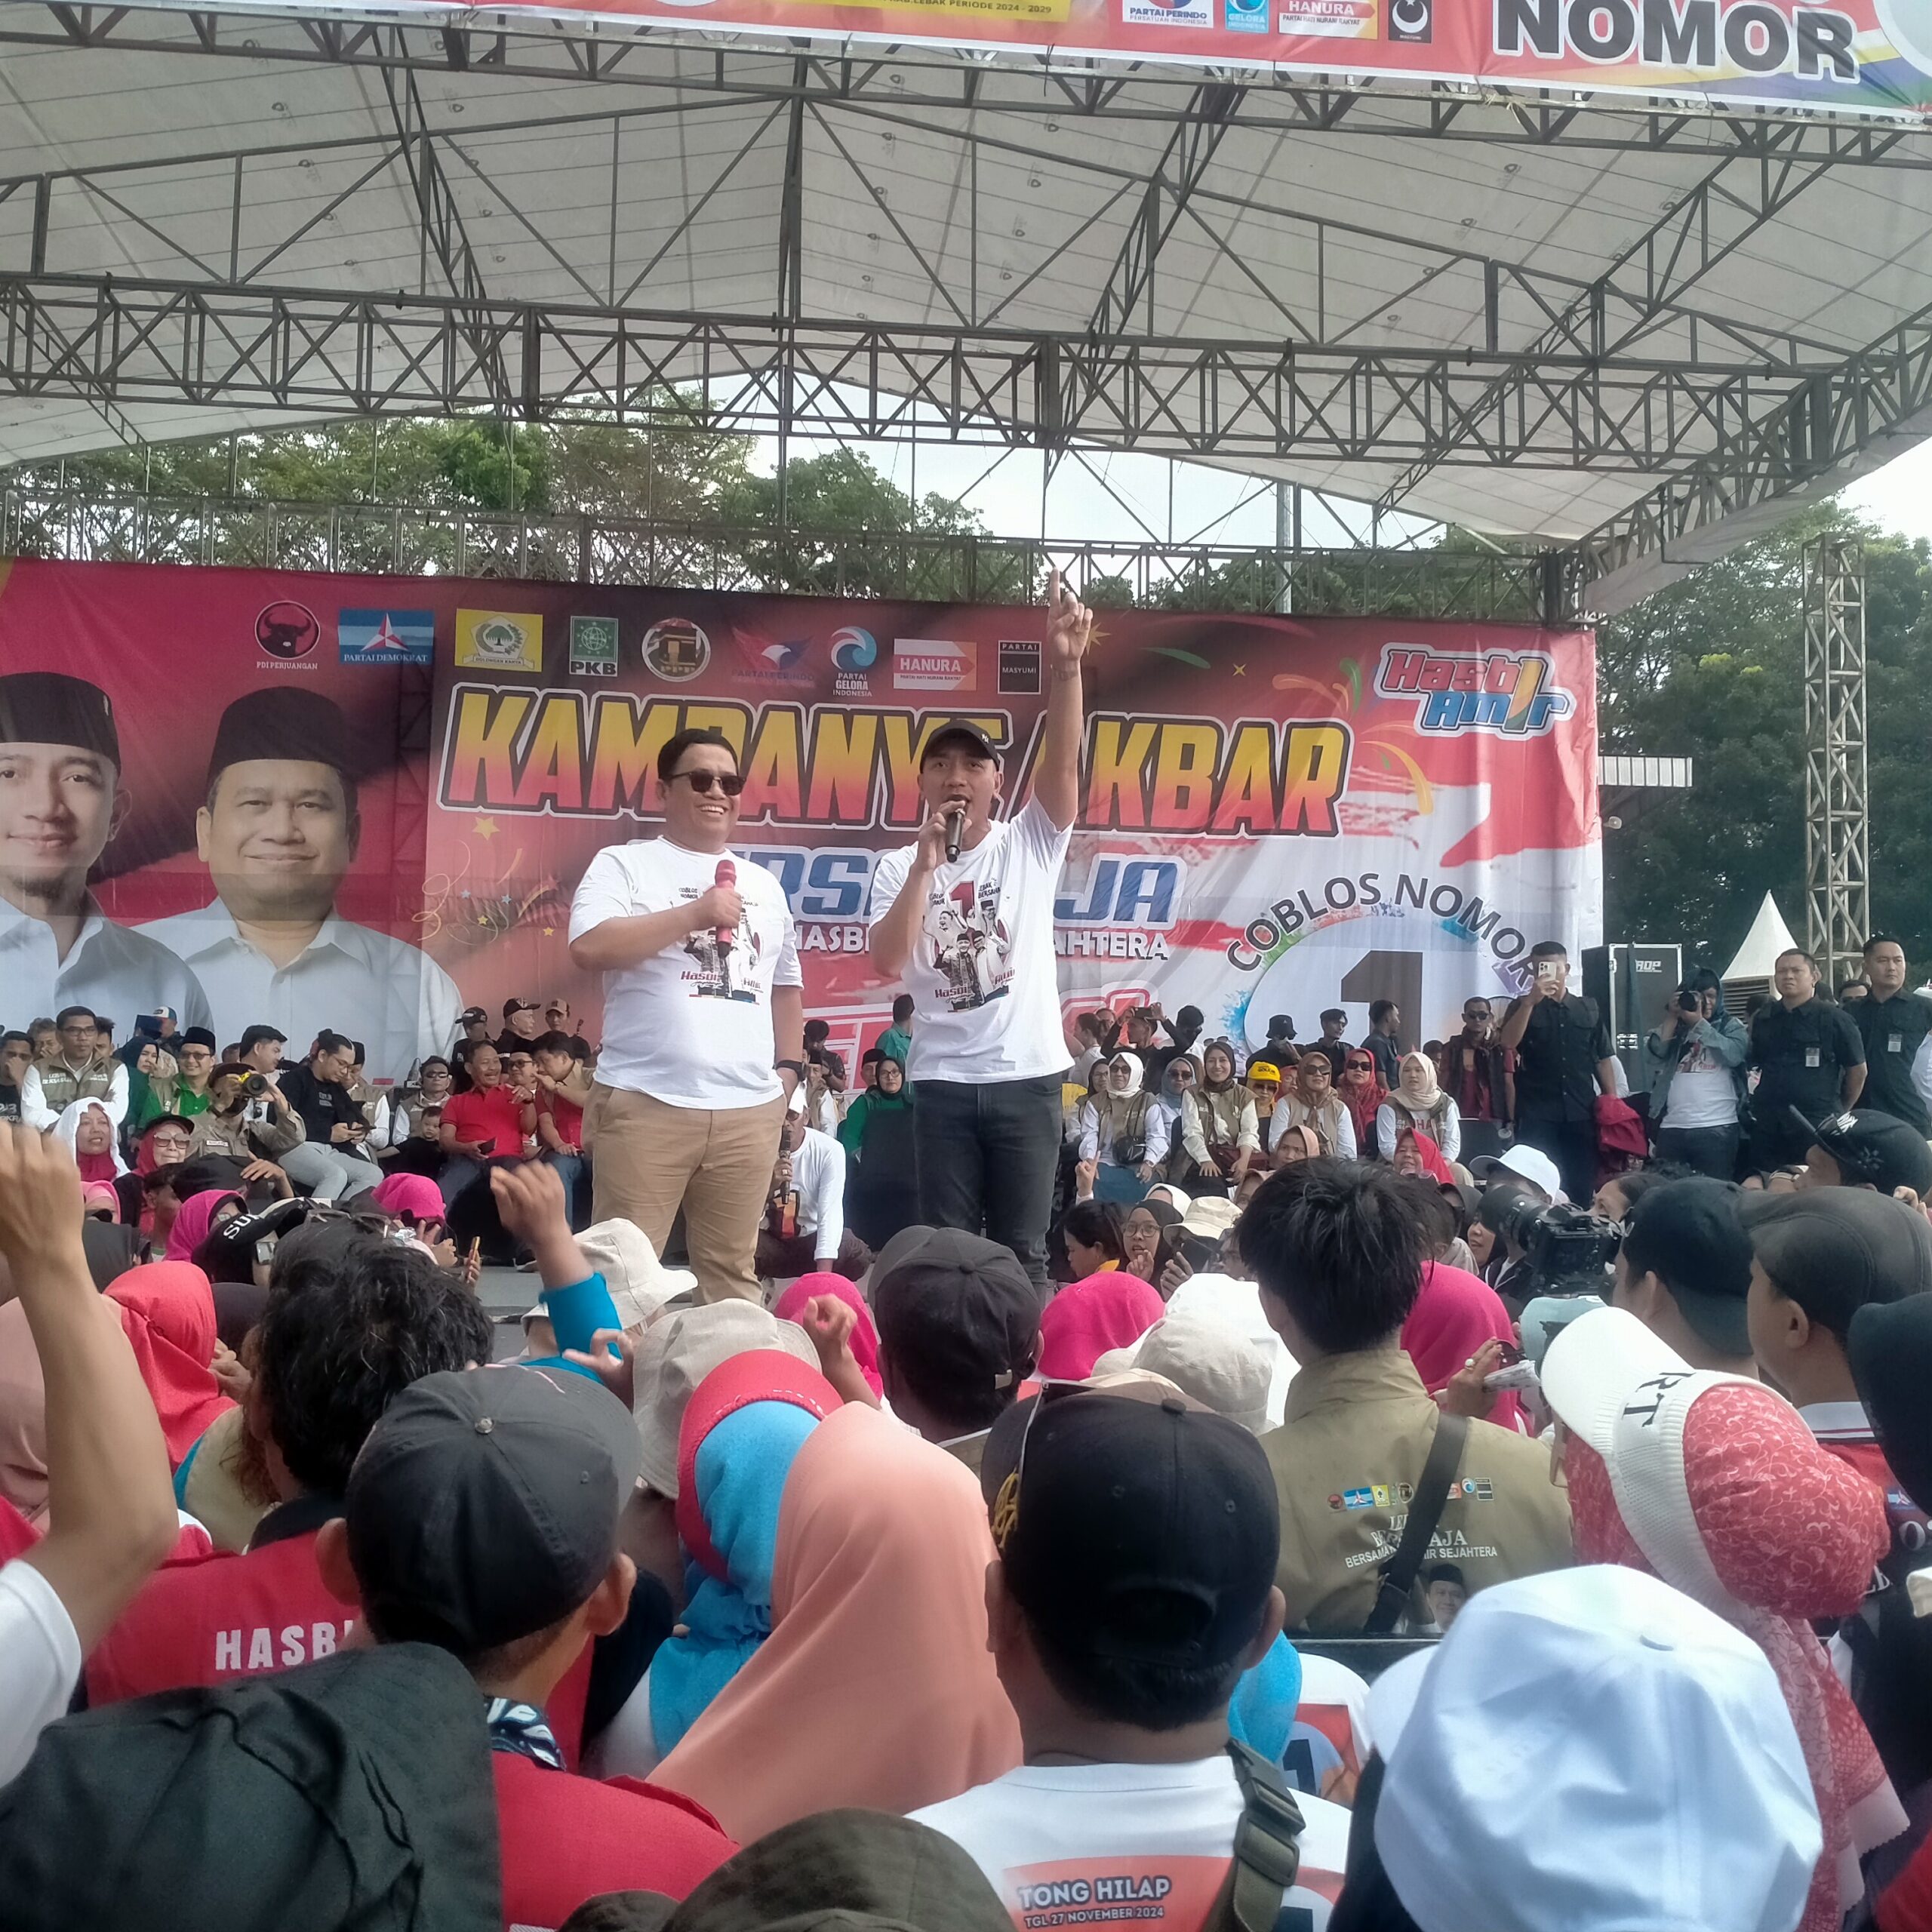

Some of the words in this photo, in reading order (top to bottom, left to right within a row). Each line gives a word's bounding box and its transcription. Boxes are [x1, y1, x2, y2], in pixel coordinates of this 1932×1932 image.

[949, 0, 993, 10] PERIODE
[995, 3, 1020, 11] 2024
[1027, 5, 1052, 14] 2029
[1129, 7, 1164, 17] PARTAI
[1166, 10, 1208, 20] PERINDO
[1288, 0, 1355, 15] HANURA
[1130, 14, 1170, 23] PERSATUAN
[1171, 17, 1208, 25] INDONESIA
[1228, 13, 1266, 23] GELORA
[1497, 0, 1858, 80] NOMOR
[344, 654, 376, 662] PARTAI
[377, 654, 429, 663] DEMOKRAT
[900, 657, 961, 672] HANURA
[571, 661, 617, 676] PKB
[838, 672, 867, 681] PARTAI
[835, 680, 869, 691] GELORA
[1019, 715, 1348, 835] KBAR
[1226, 872, 1382, 974] COBLOS
[1393, 873, 1536, 988] NOMOR
[1340, 949, 1423, 1058] 1
[1438, 1546, 1498, 1559] SEJAHTERA
[1019, 1881, 1091, 1909] TONG
[1097, 1877, 1171, 1901] HILAP
[1025, 1916, 1048, 1928] TGL
[1051, 1913, 1064, 1924] 27
[1067, 1908, 1133, 1923] NOVEMBER
[1136, 1906, 1164, 1918] 2024
